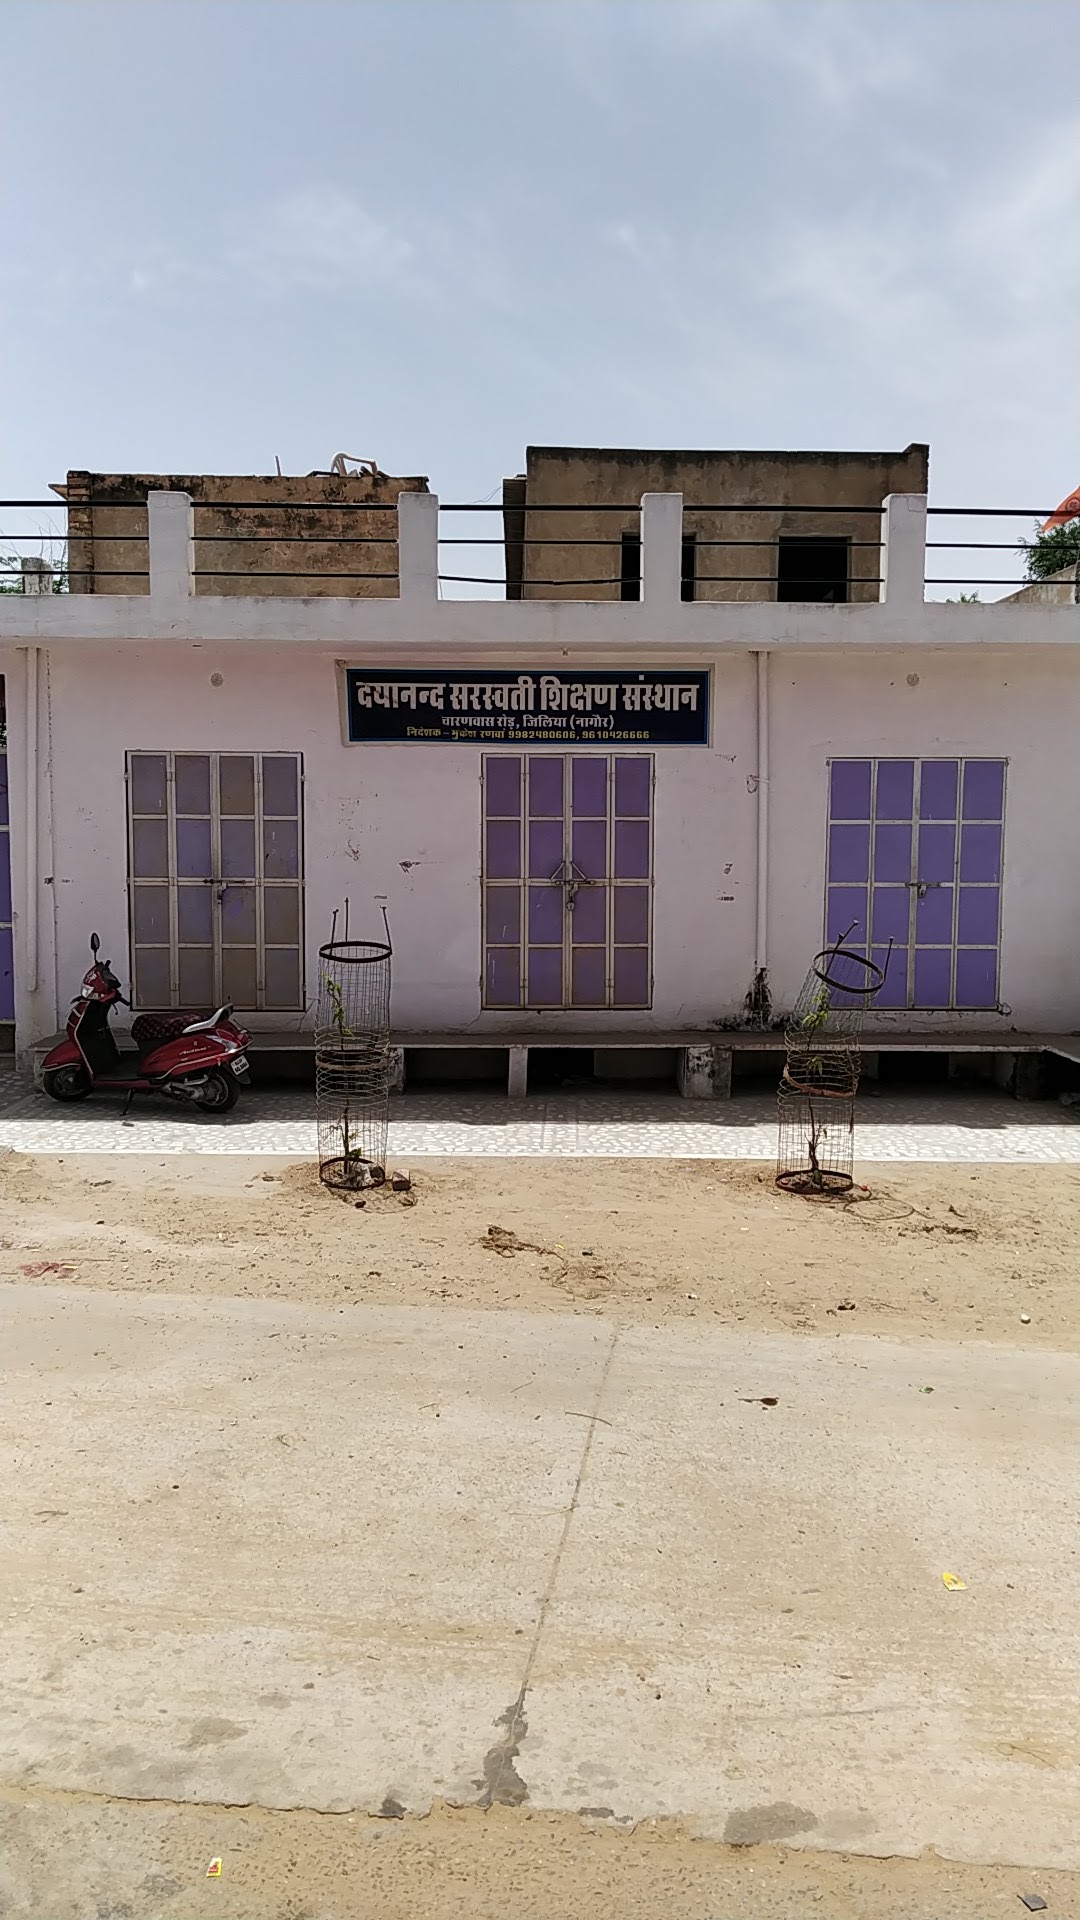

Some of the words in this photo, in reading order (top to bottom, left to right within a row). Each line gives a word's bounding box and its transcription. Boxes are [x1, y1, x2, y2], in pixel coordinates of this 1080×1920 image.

[355, 681, 446, 710] दयानन्द
[449, 675, 537, 711] सरस्वती
[540, 675, 619, 711] शिक्षण
[622, 674, 699, 711] संस्थान
[441, 715, 495, 727] चारणवास
[523, 714, 567, 728] जिलिया
[570, 714, 614, 729] (नागौर)
[407, 726, 441, 737] निदेशक
[582, 730, 650, 739] 9610426666
